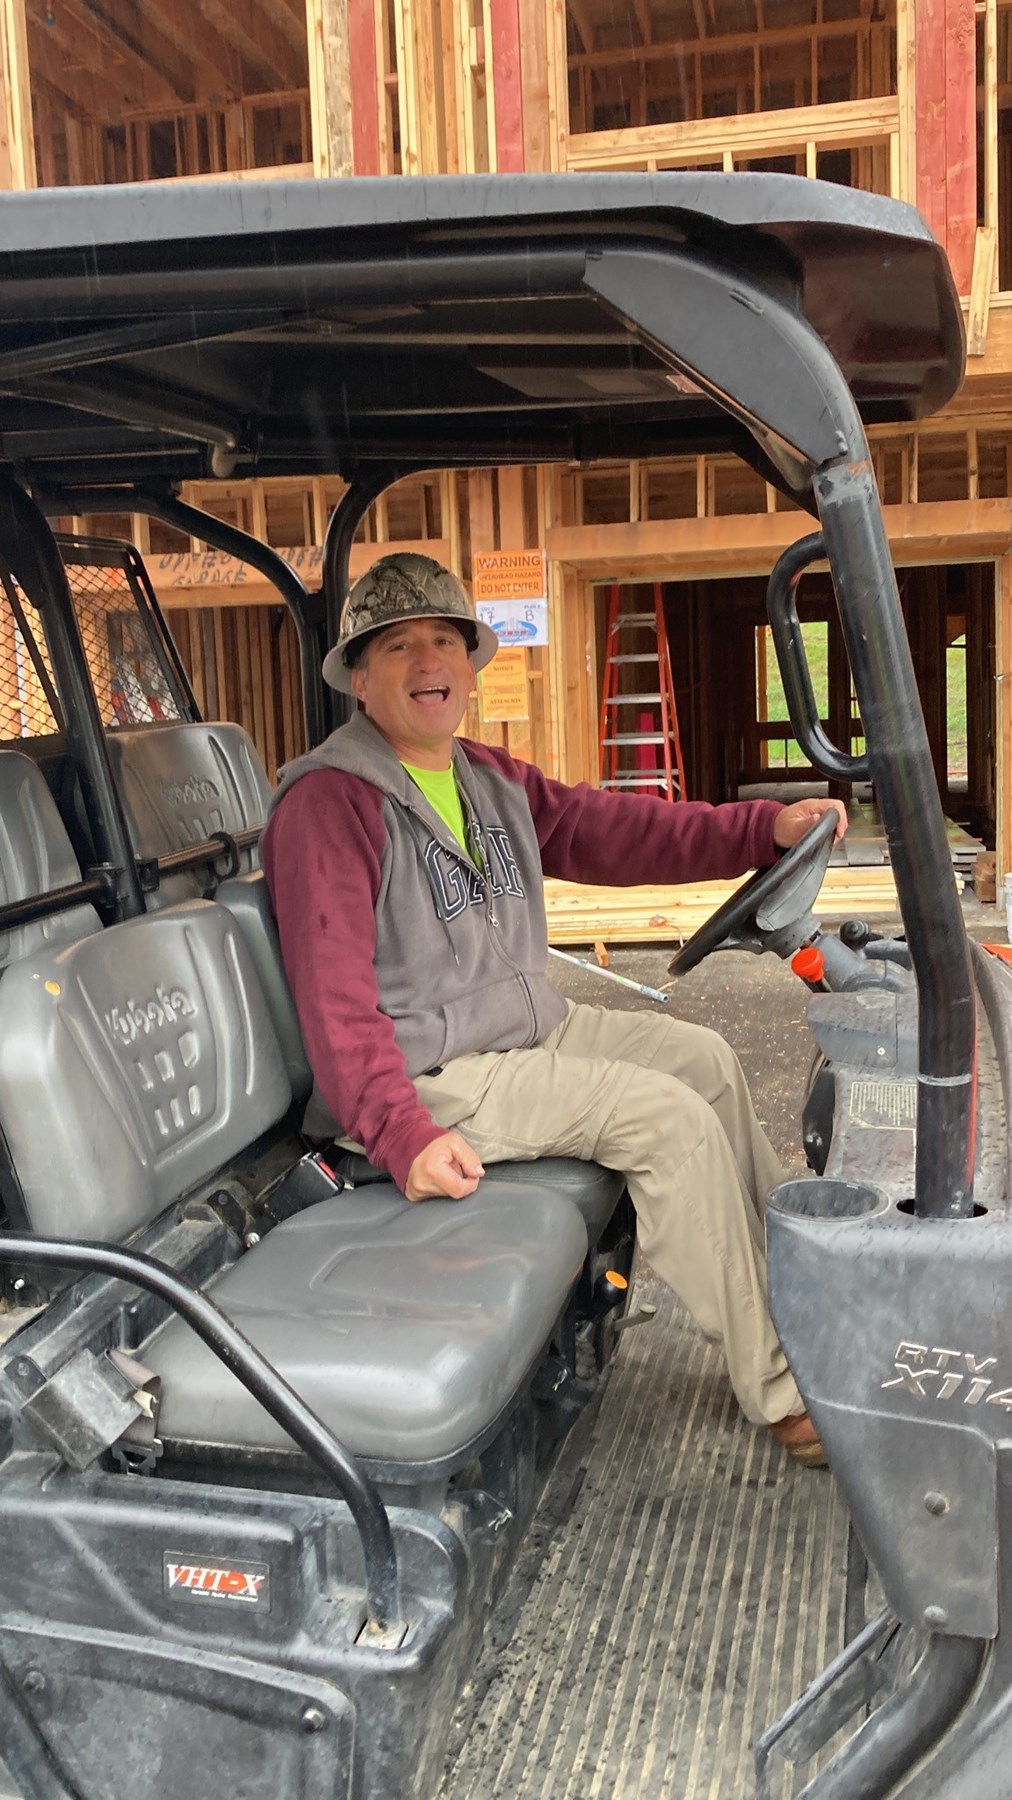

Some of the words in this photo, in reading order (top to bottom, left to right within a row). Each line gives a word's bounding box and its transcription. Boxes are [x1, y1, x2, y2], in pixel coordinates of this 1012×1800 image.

[478, 555, 541, 569] WARNING
[479, 572, 514, 581] OVERHEAD
[515, 571, 541, 579] HAZARD
[481, 584, 493, 594] DO
[494, 583, 511, 593] NOT
[513, 581, 540, 592] ENTER
[479, 611, 496, 624] 17
[525, 609, 535, 621] B
[894, 1341, 998, 1376] RTV
[166, 1563, 265, 1597] VHT-X
